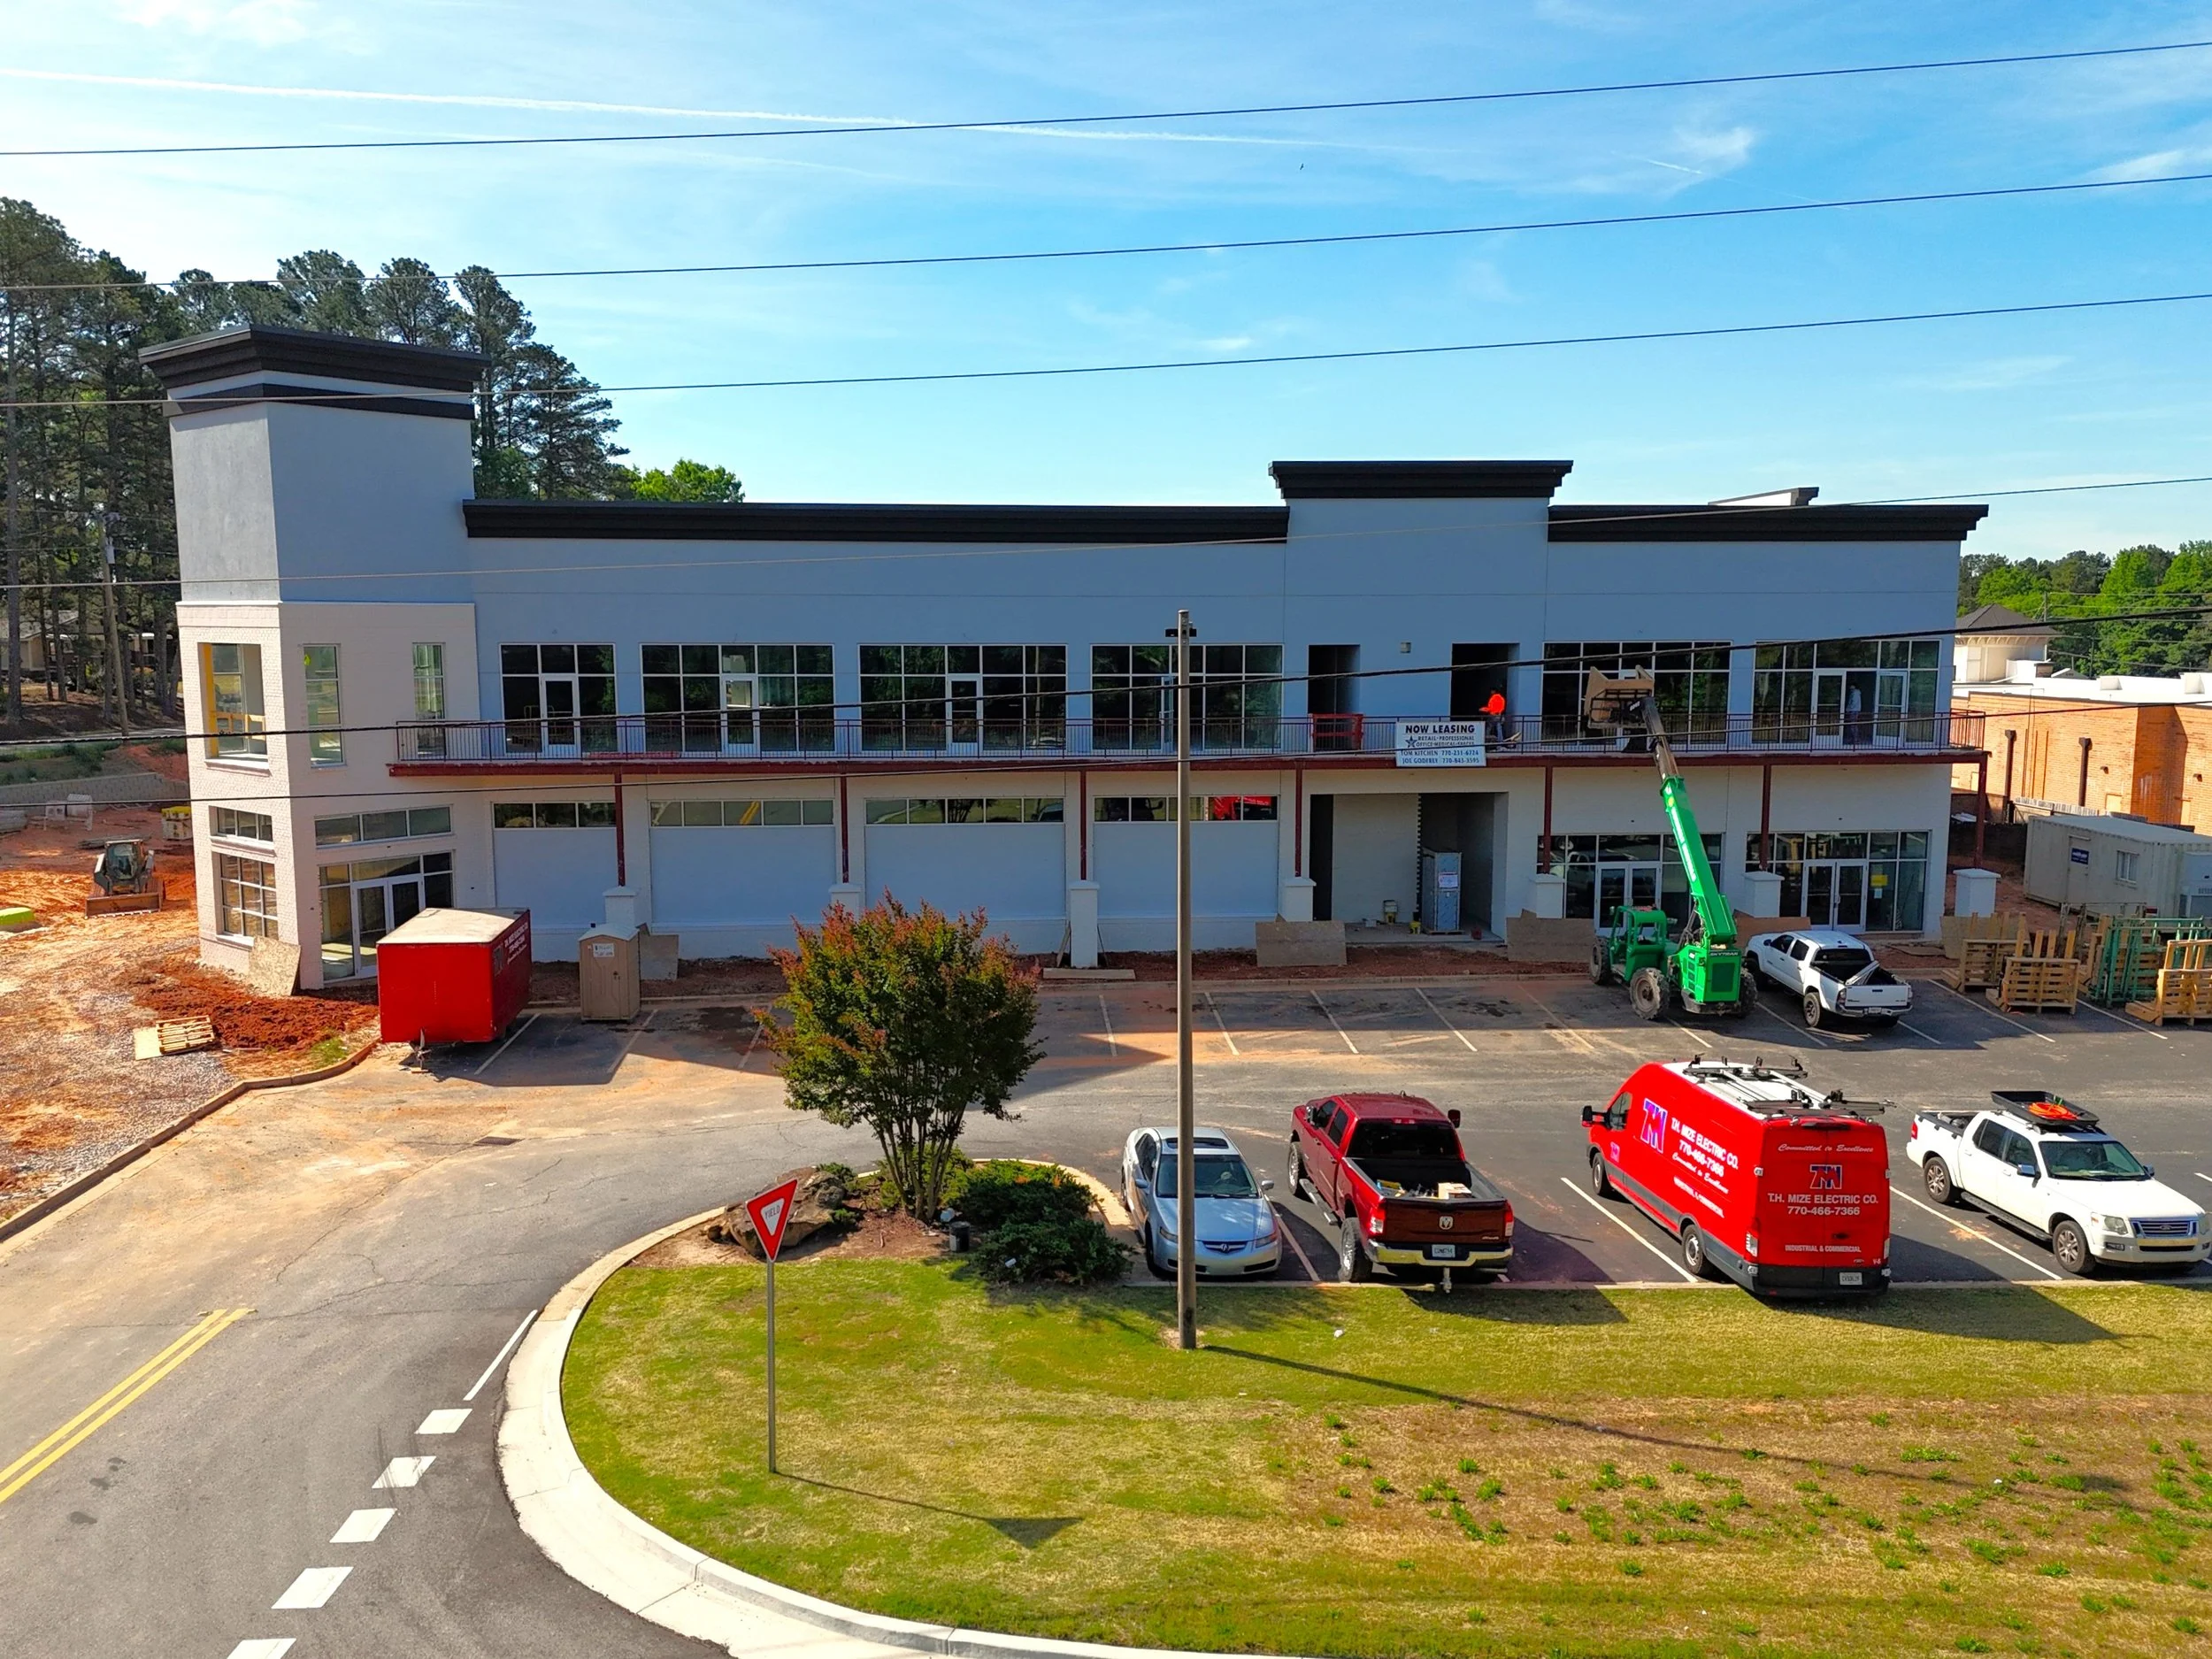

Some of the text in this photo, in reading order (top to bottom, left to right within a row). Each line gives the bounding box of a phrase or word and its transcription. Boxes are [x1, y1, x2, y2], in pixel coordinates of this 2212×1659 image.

[1405, 725, 1476, 733] NOW LEASING
[1681, 1124, 1697, 1143] MIZE
[1696, 1133, 1727, 1162] ELECTRIC
[1767, 1193, 1878, 1204] T.H. MIZE ELECTRIC CO.
[764, 1203, 781, 1220] YIELD
[1787, 1206, 1860, 1216] 770-466-7366
[1785, 1244, 1818, 1253] INDUSTRIAL
[1824, 1245, 1862, 1254] COMMERCIAL
